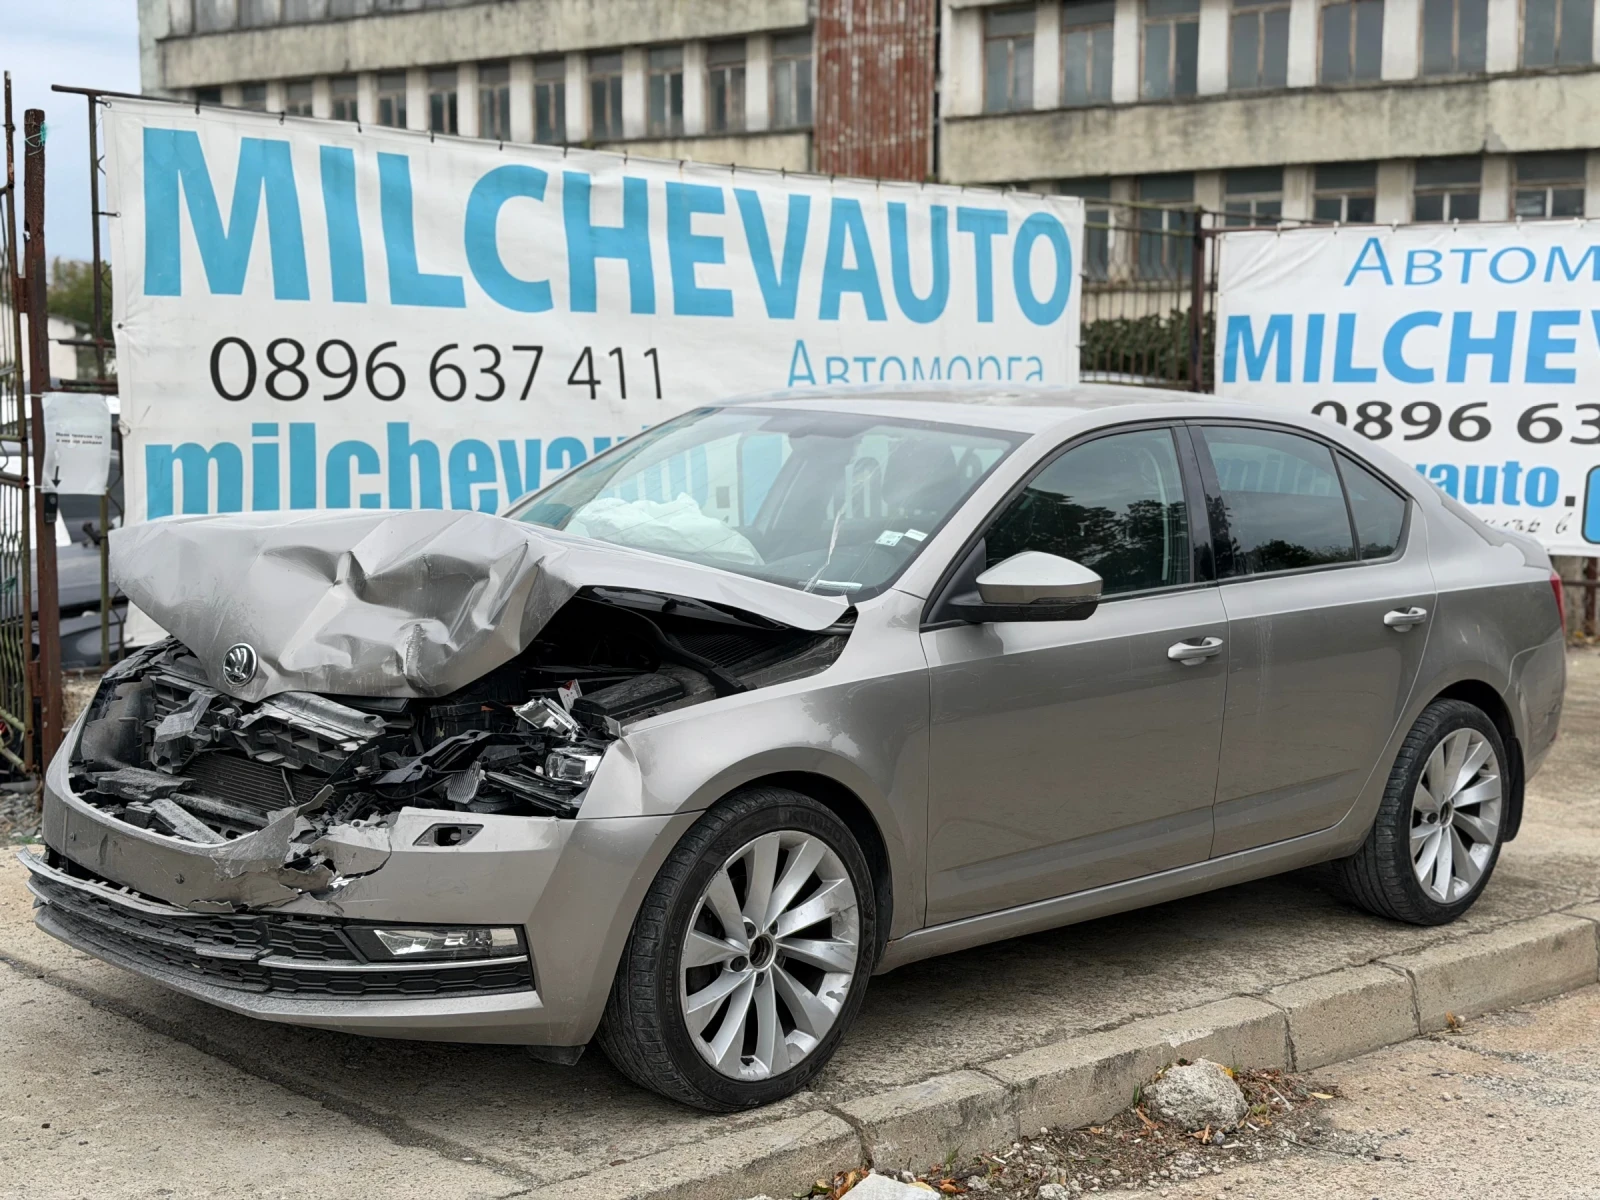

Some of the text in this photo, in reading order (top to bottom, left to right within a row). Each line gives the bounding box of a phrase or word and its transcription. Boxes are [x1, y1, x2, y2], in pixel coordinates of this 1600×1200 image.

[143, 127, 1073, 327] MILCHEVAUTO
[209, 336, 663, 402] 0896 637 411
[1222, 310, 1600, 384] MILCHE
[1517, 402, 1600, 444] 63
